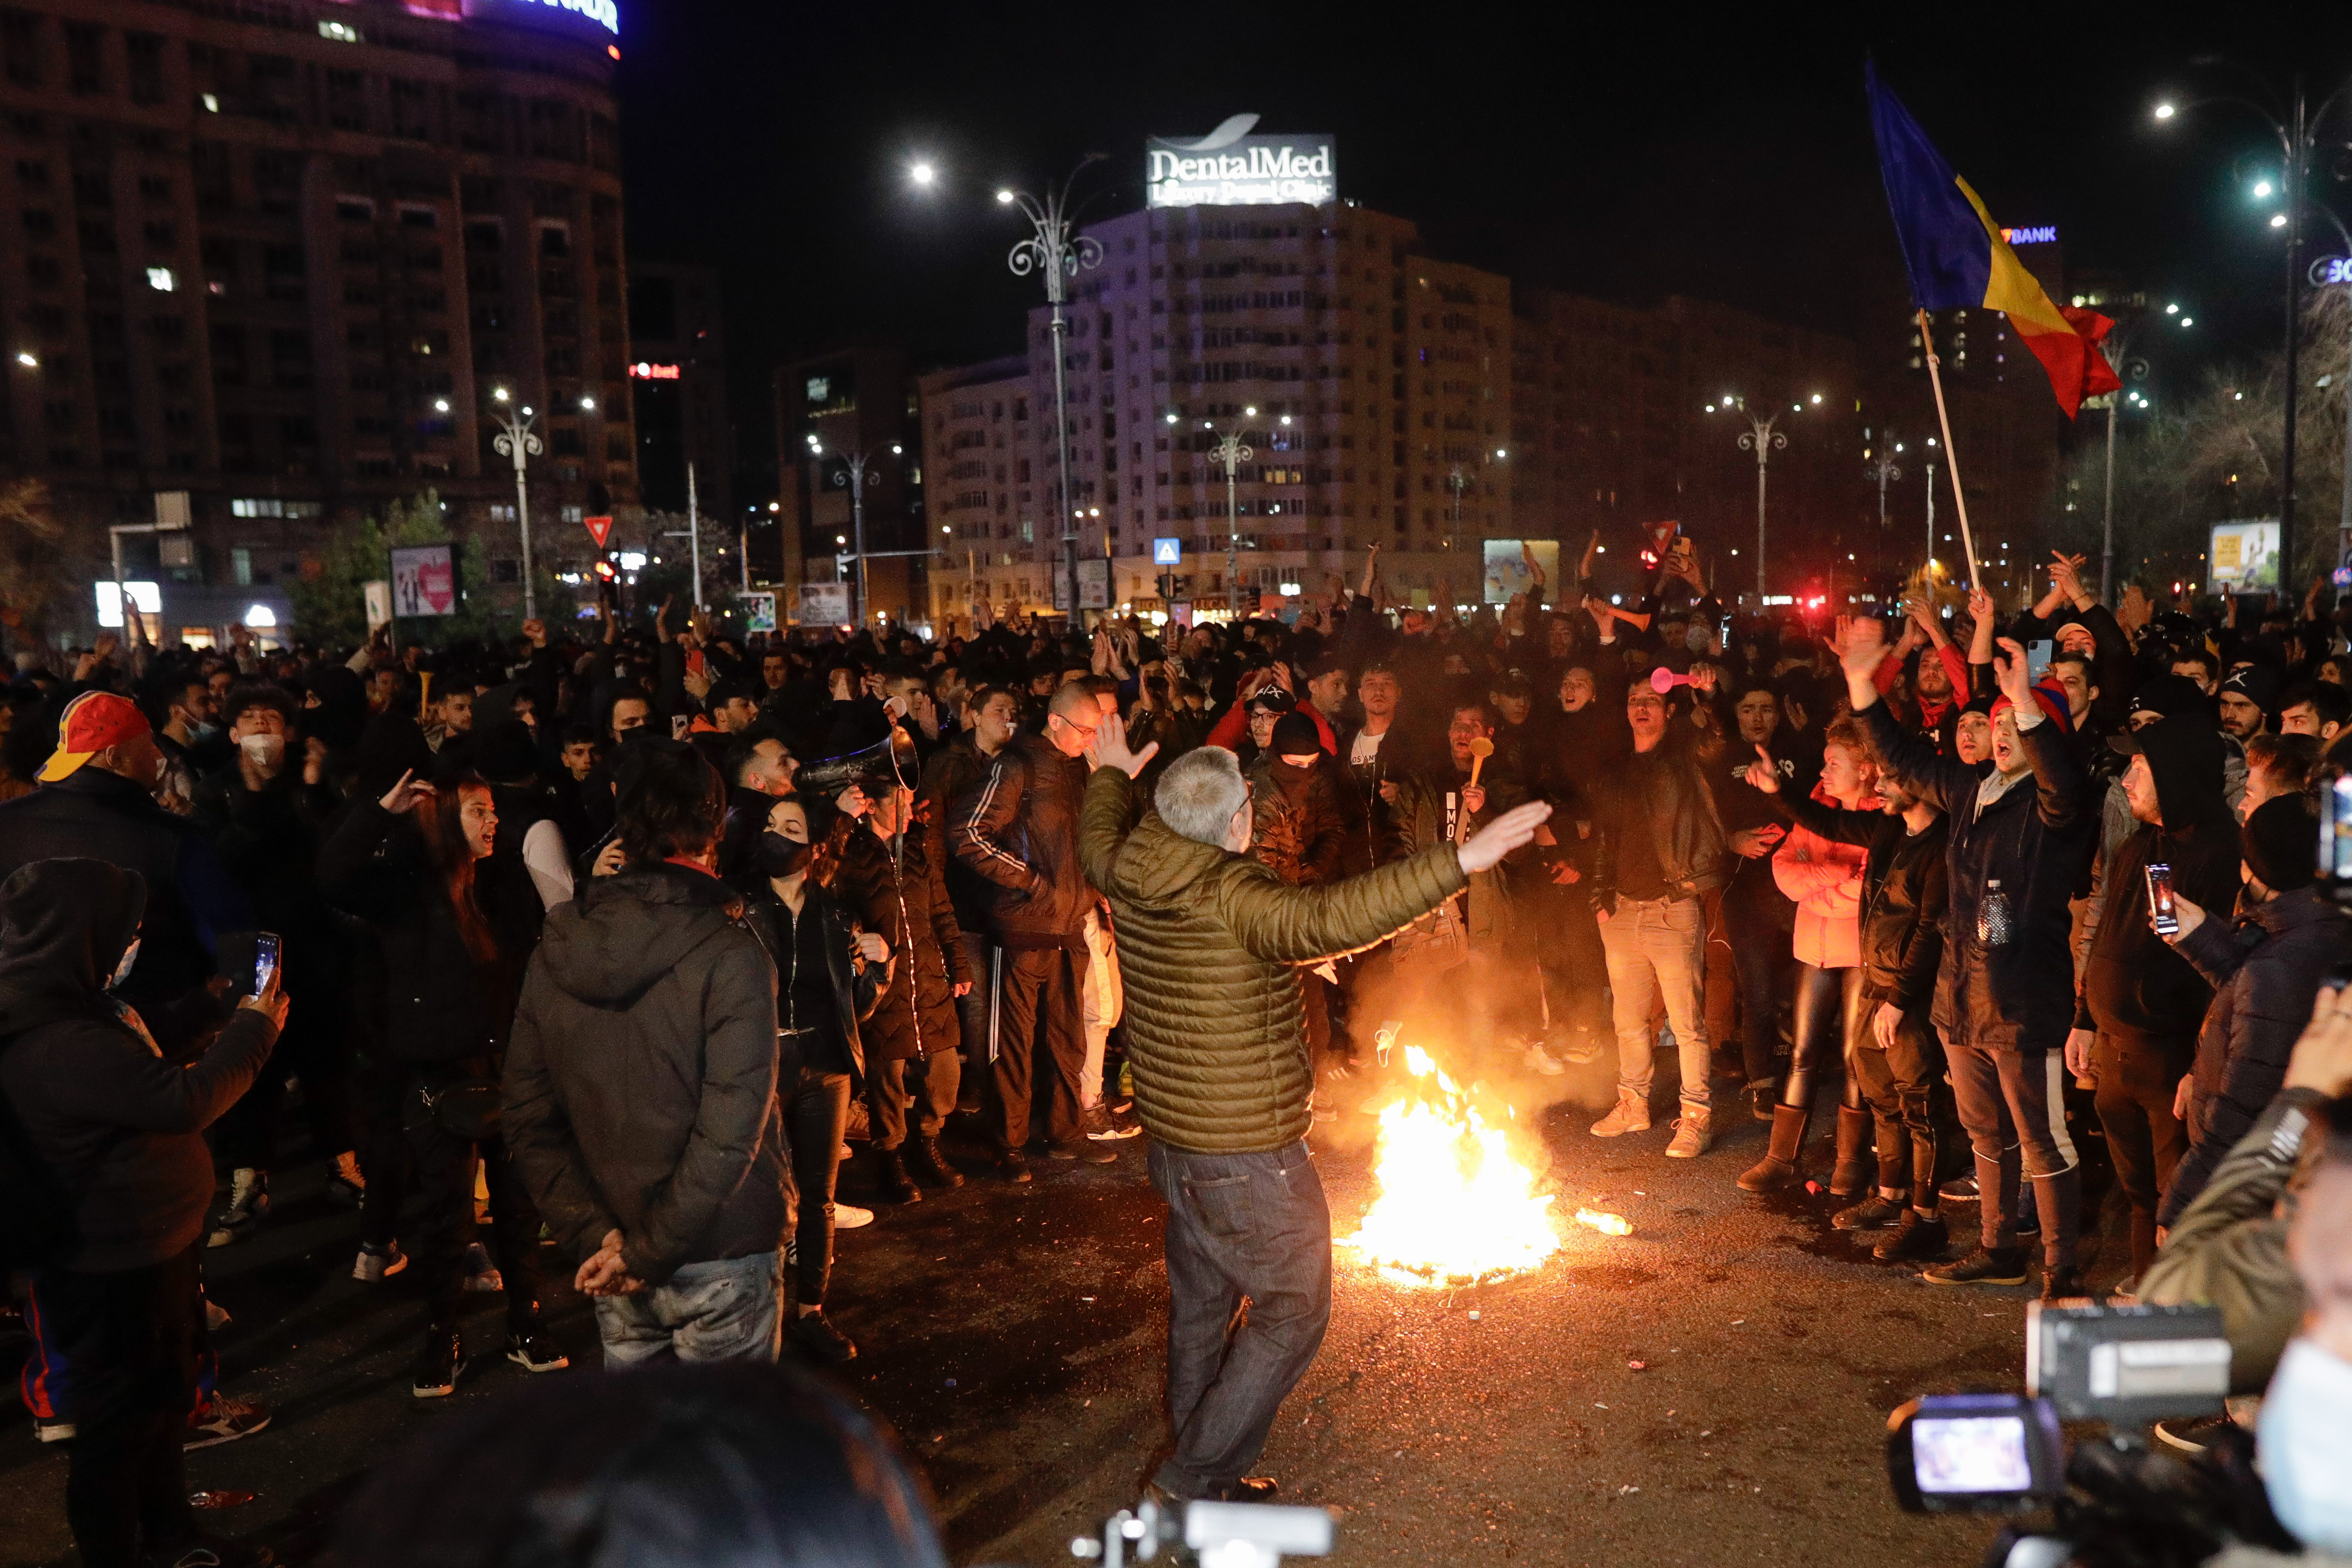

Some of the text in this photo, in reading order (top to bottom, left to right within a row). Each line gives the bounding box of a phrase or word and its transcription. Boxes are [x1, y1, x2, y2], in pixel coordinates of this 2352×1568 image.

[1151, 145, 1332, 182] DentalMed
[2011, 226, 2057, 245] BANK
[1446, 810, 1456, 841] MO
